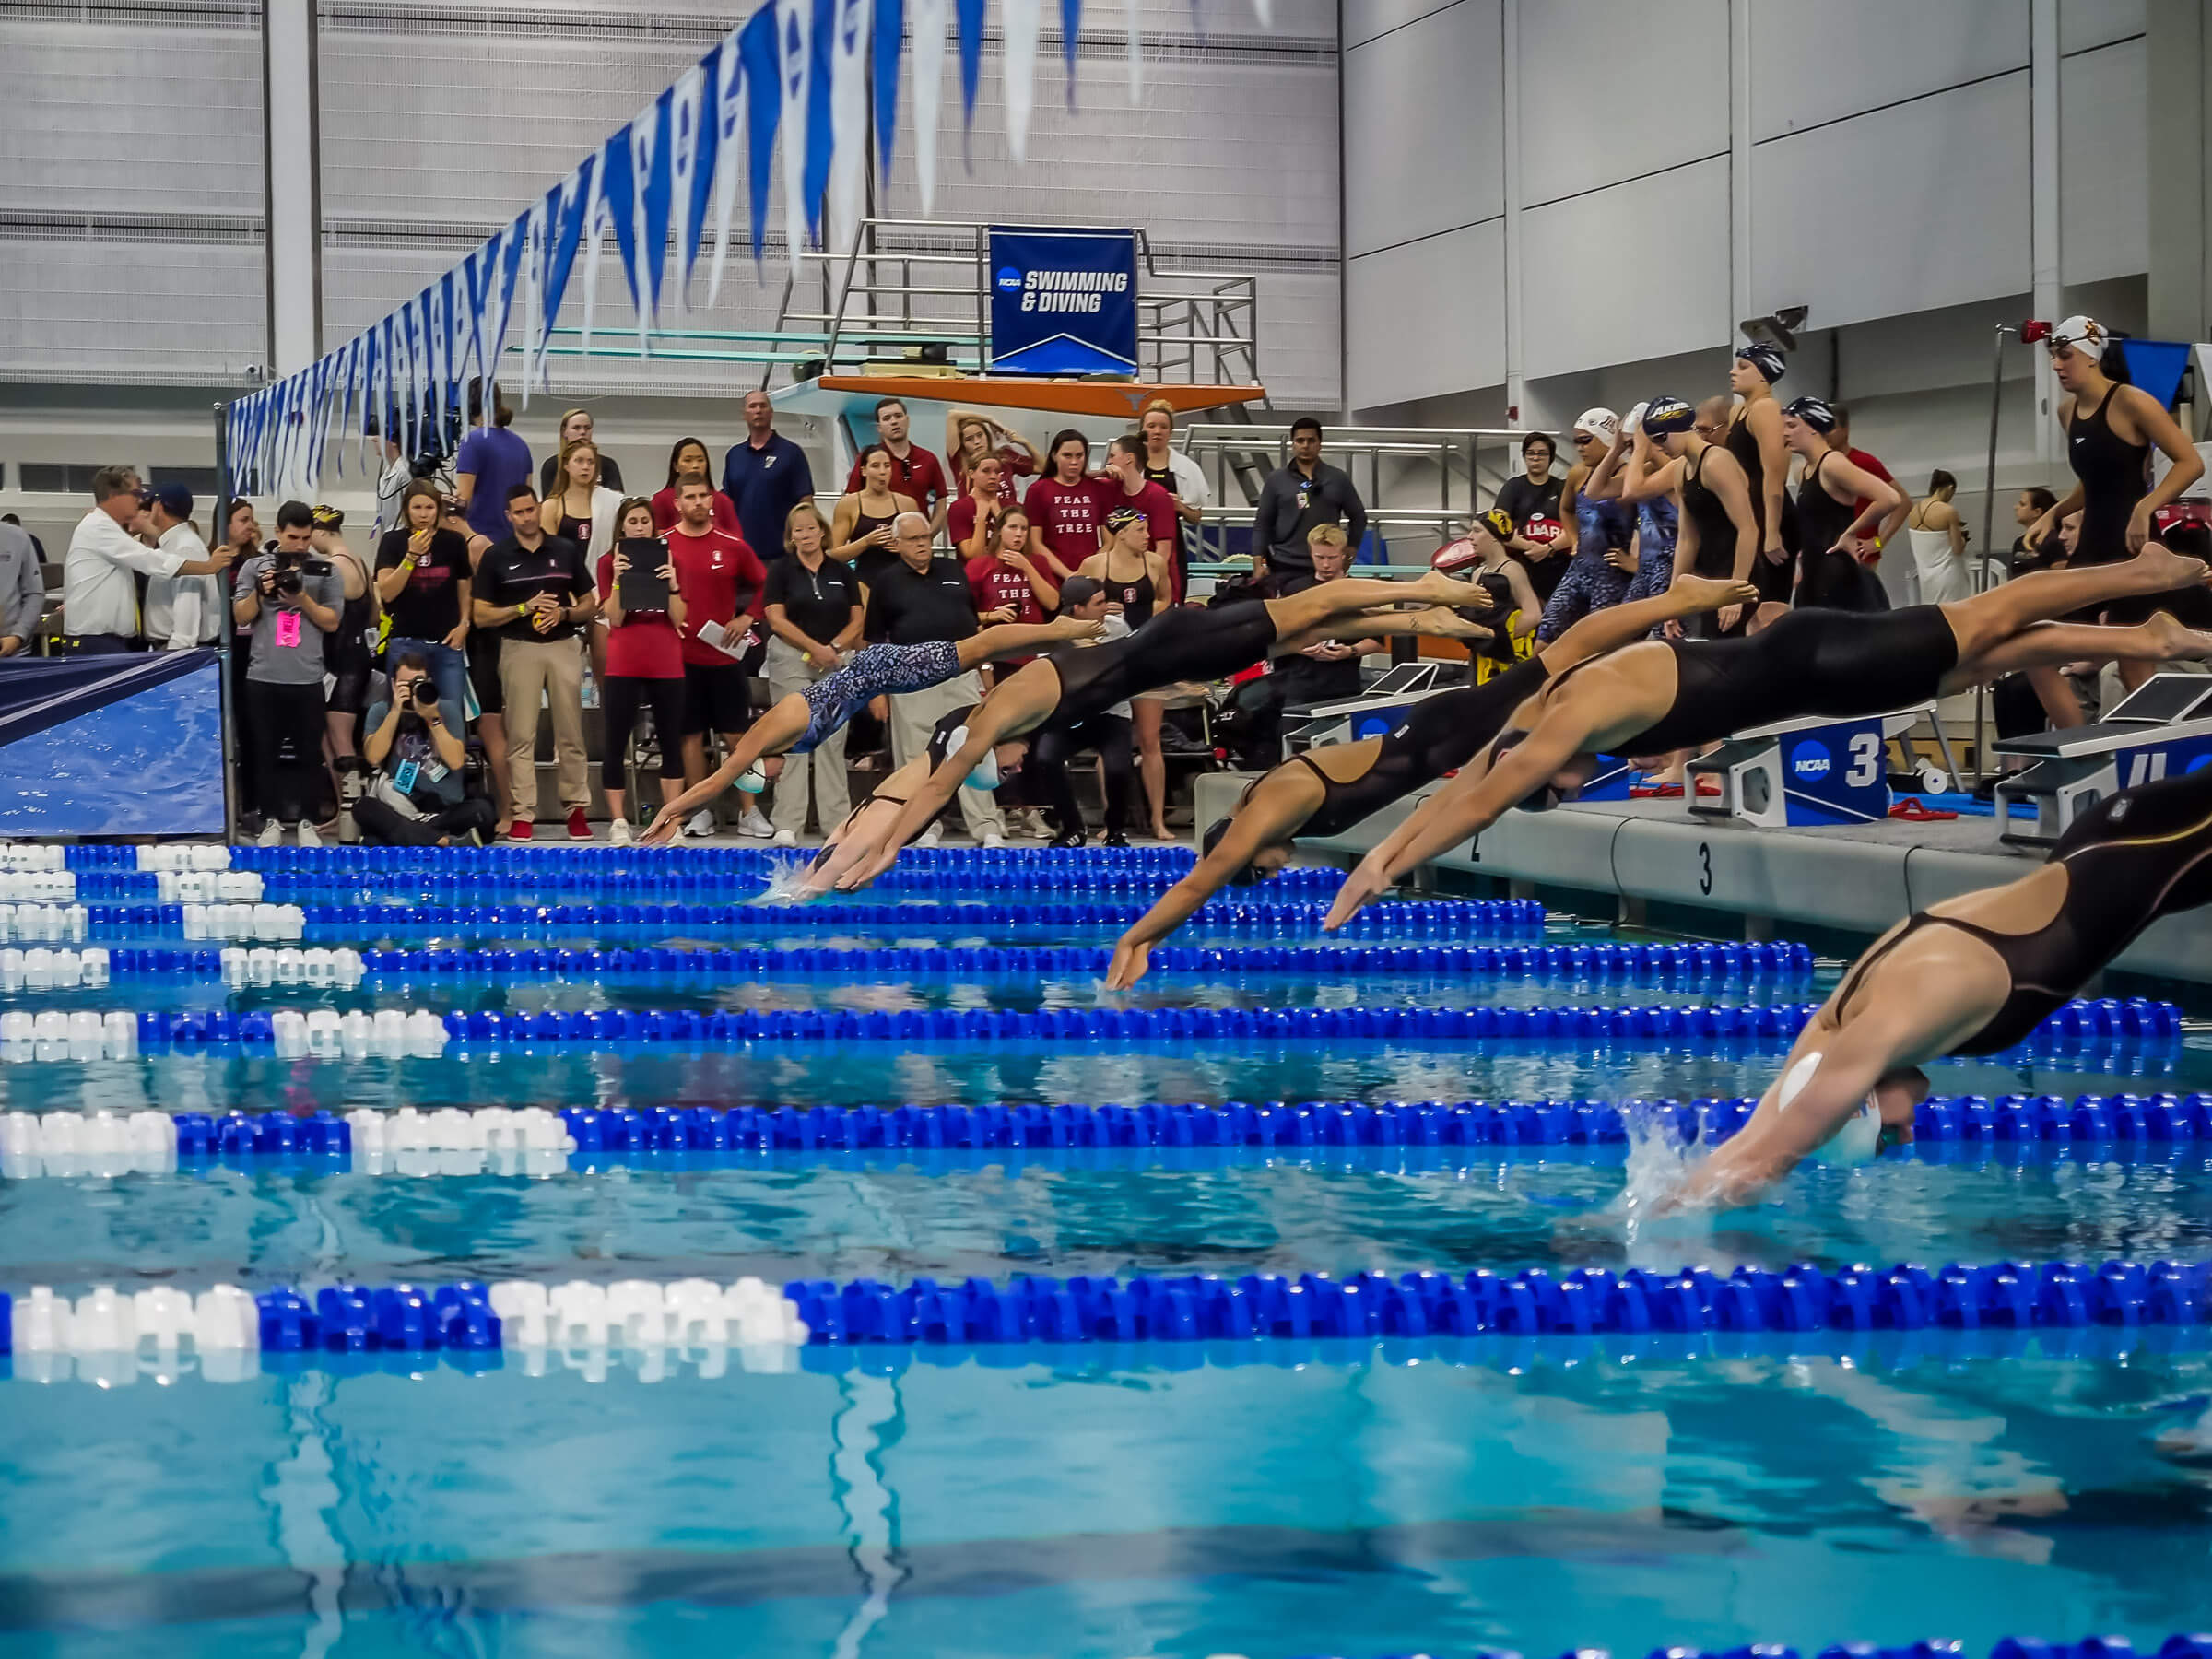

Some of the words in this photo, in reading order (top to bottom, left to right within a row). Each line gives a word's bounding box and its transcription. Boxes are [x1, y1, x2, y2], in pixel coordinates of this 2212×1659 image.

[998, 278, 1022, 287] NCAA
[1024, 270, 1129, 293] SWIMMING
[1020, 291, 1037, 312] &
[1038, 292, 1102, 312] DIVING
[1053, 495, 1092, 505] FEAR
[1059, 509, 1091, 518] THE
[1055, 524, 1093, 534] TREE
[998, 588, 1031, 599] THE
[1794, 759, 1830, 773] NCAA
[1844, 732, 1881, 788] 3
[1699, 841, 1713, 896] 3
